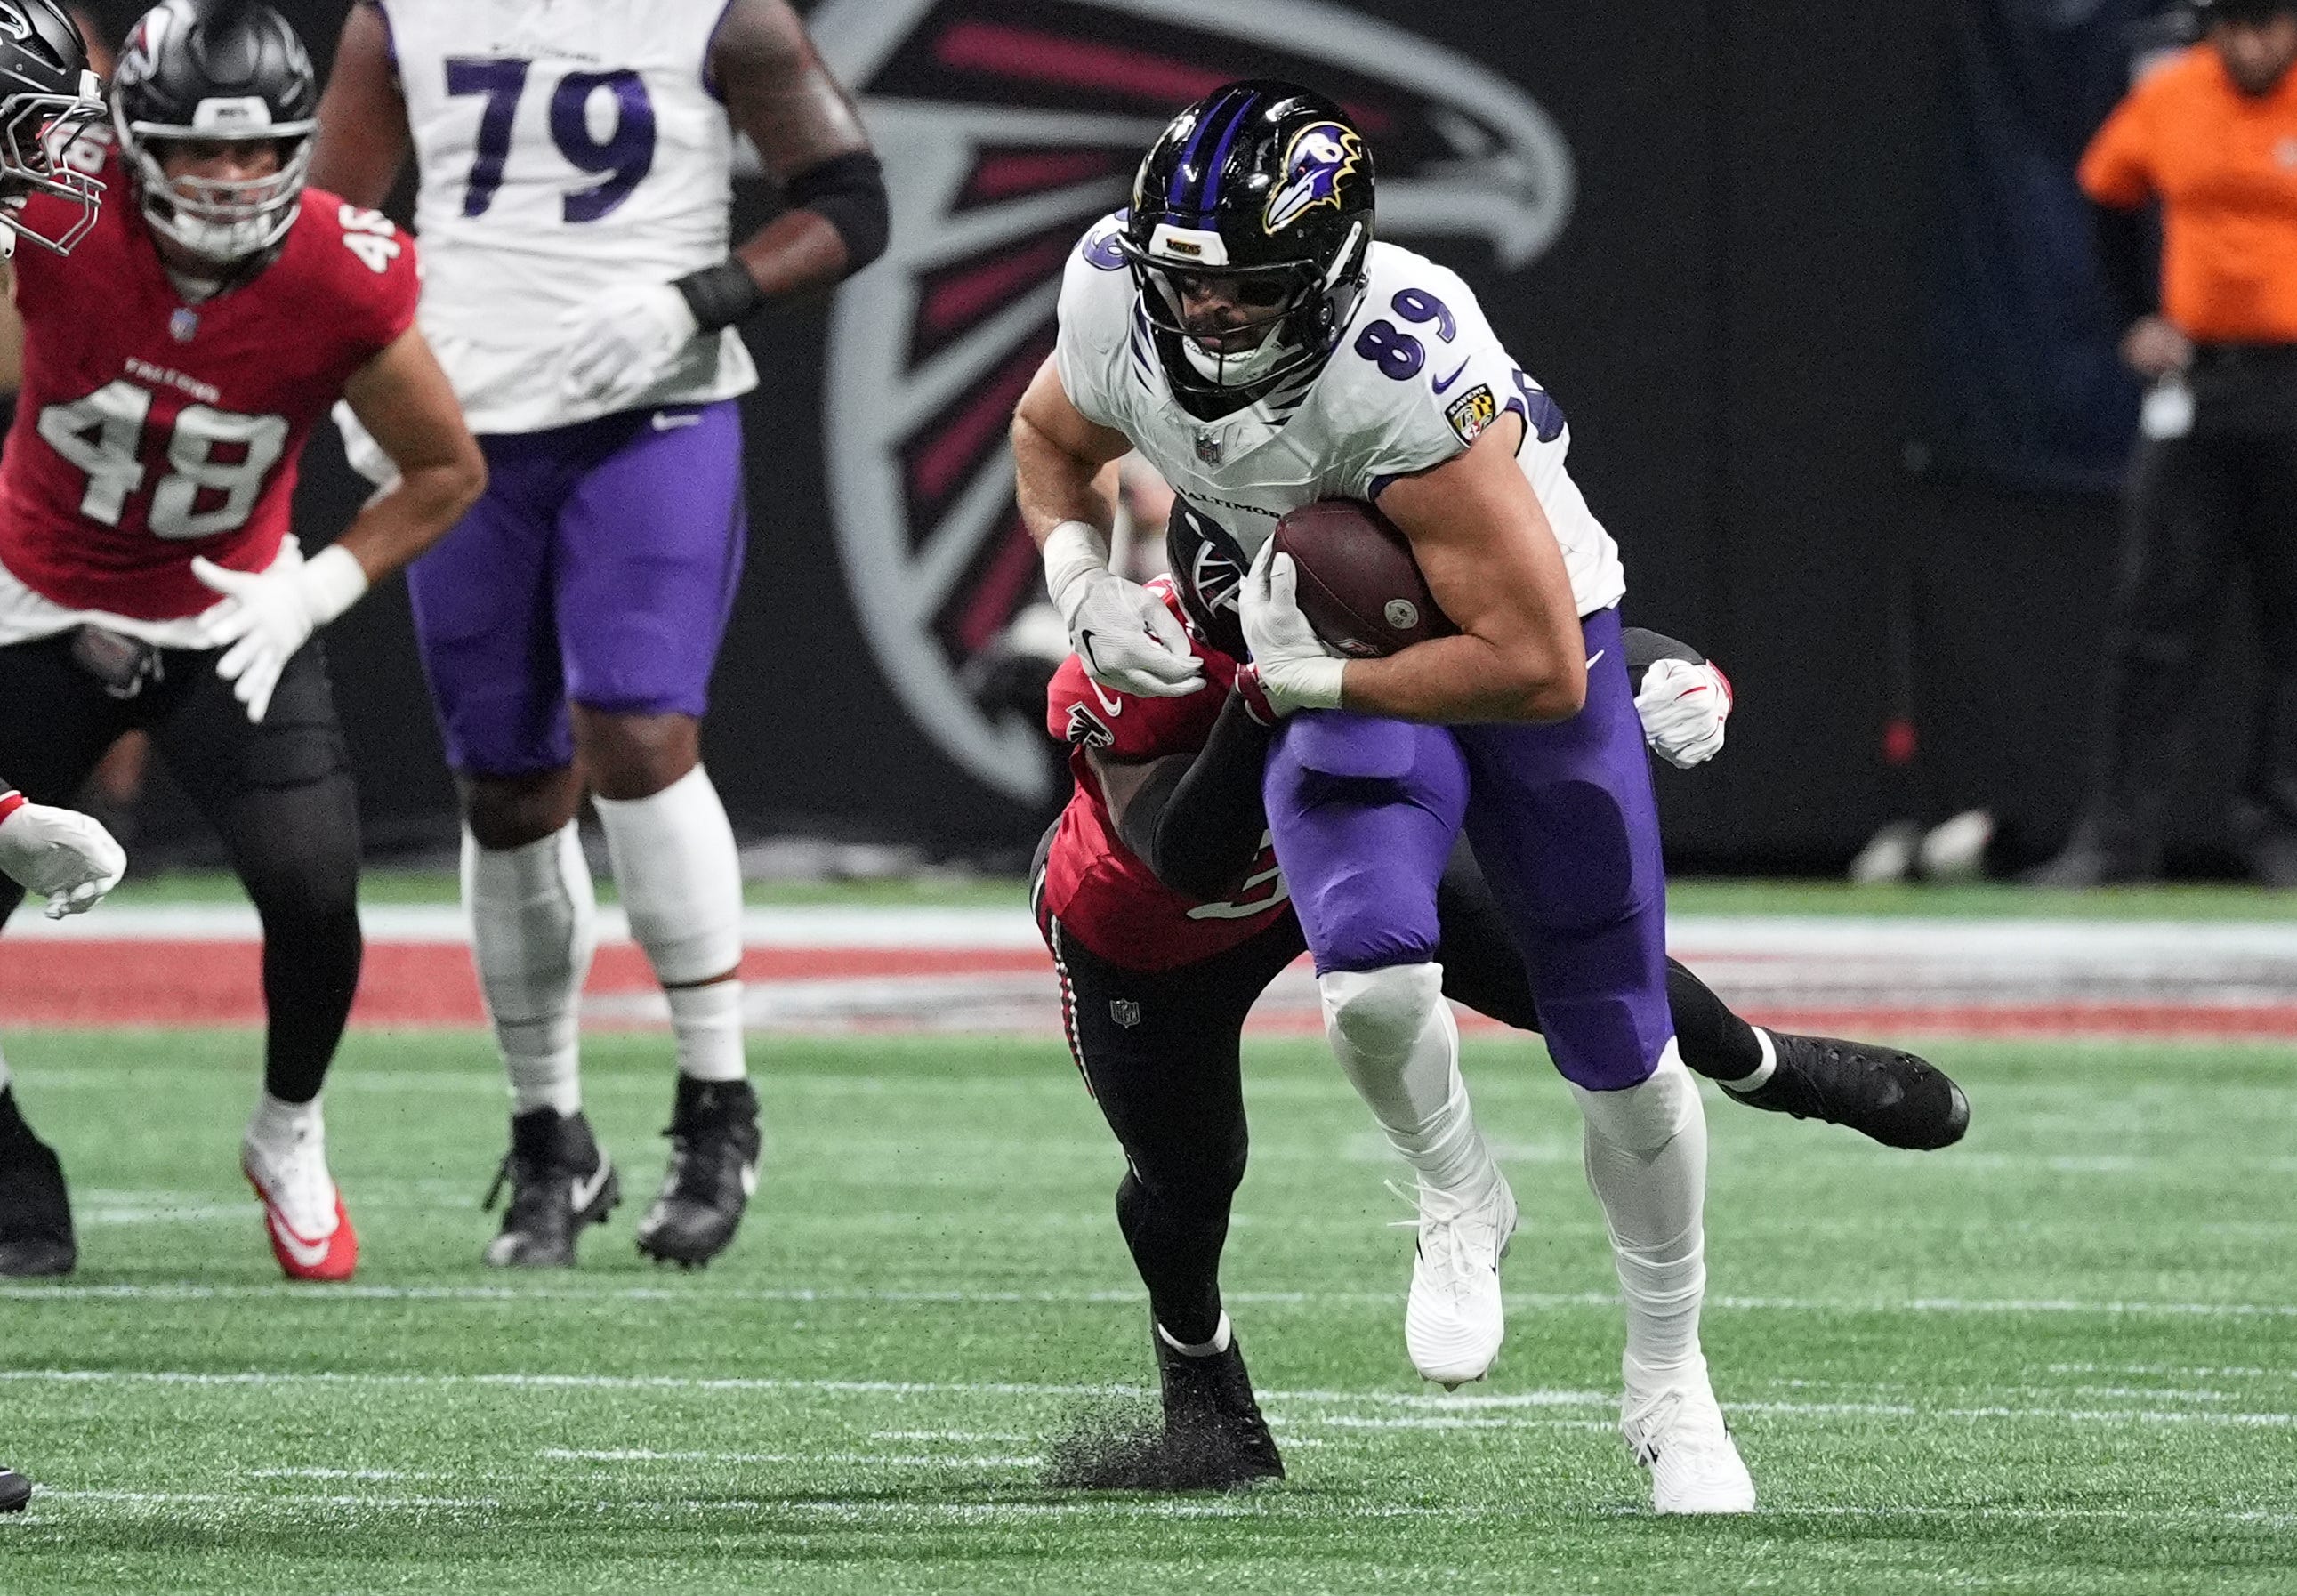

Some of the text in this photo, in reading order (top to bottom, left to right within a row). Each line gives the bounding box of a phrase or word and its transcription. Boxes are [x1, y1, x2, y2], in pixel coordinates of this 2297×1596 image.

[444, 57, 657, 223] 79
[1354, 288, 1456, 381] 89
[36, 379, 289, 540] 48
[1447, 385, 1487, 415] RAVENS
